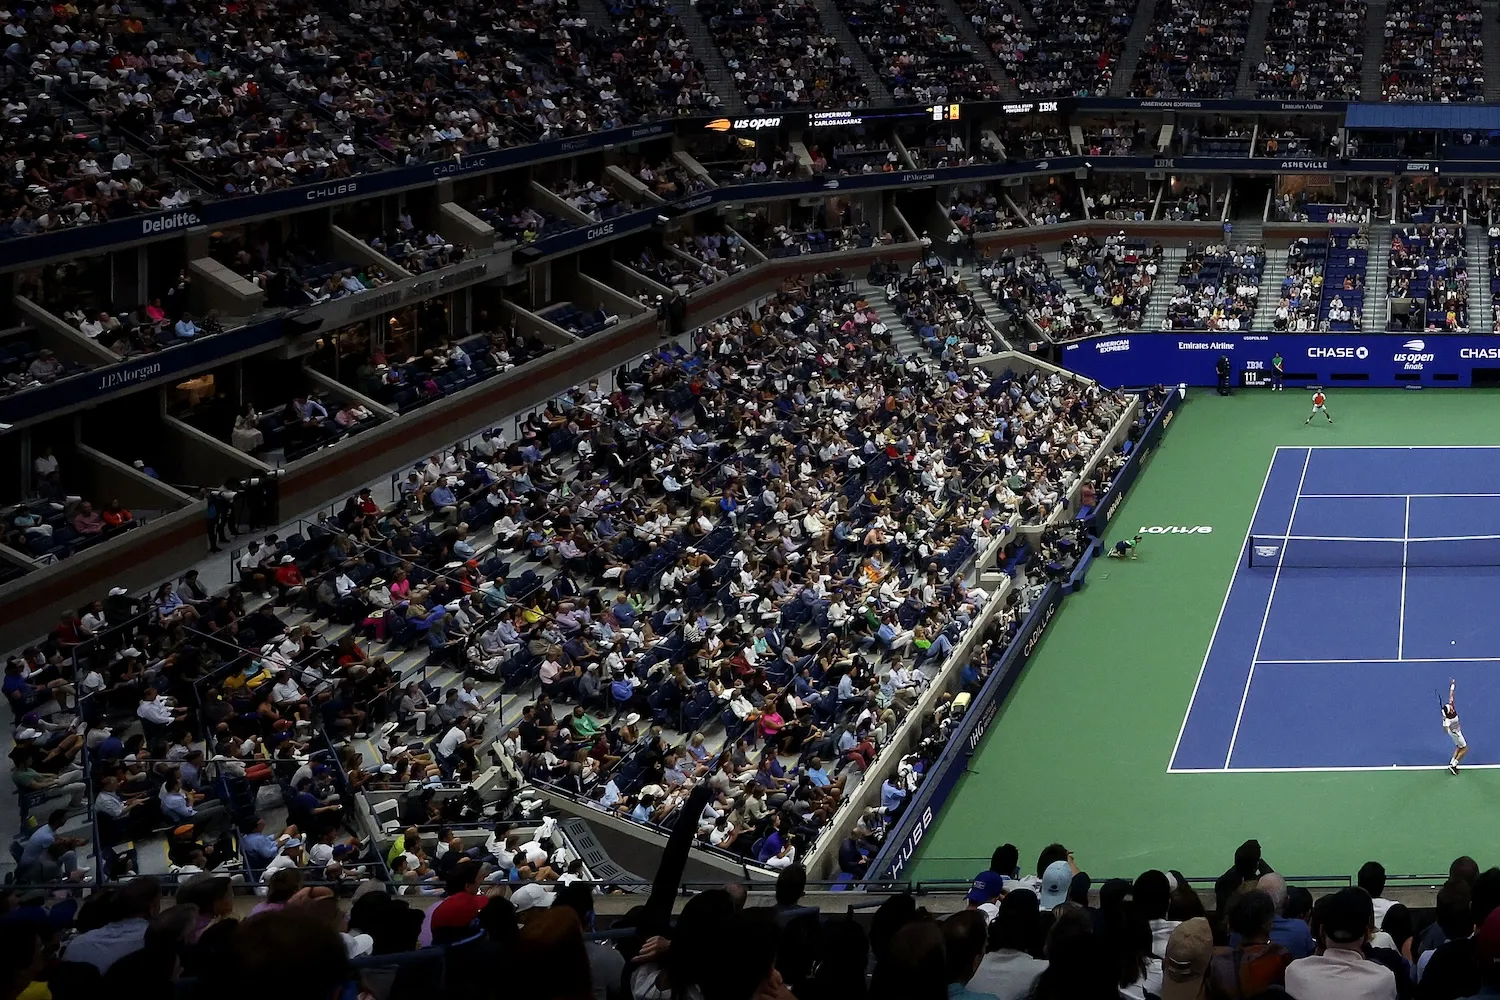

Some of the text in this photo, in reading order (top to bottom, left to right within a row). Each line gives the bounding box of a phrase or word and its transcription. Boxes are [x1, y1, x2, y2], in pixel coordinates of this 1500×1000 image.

[1039, 102, 1058, 112] IBM
[734, 117, 781, 130] us open
[814, 119, 836, 127] CARLOS
[836, 118, 862, 126] ALCARAZ
[433, 158, 487, 176] CADILLAC
[1154, 158, 1175, 168] IBM
[1281, 161, 1328, 169] ASHEVILLE
[1406, 163, 1430, 171] ESPN
[306, 182, 357, 200] CHUBB
[142, 212, 201, 234] Deloitte.
[587, 223, 614, 240] CHASE
[1095, 339, 1129, 349] AMERICAN
[1178, 341, 1235, 350] Emirates Airline
[1100, 345, 1130, 354] EXPRESS
[1307, 347, 1354, 358] CHASE
[1393, 353, 1435, 364] us open
[1246, 360, 1264, 370] IBM
[1404, 362, 1424, 370] finals
[1244, 371, 1257, 382] 111
[1138, 525, 1213, 534] 9/11/01
[1023, 602, 1056, 658] CADILLAC
[969, 720, 984, 750] IHG
[888, 805, 933, 881] HUBB
